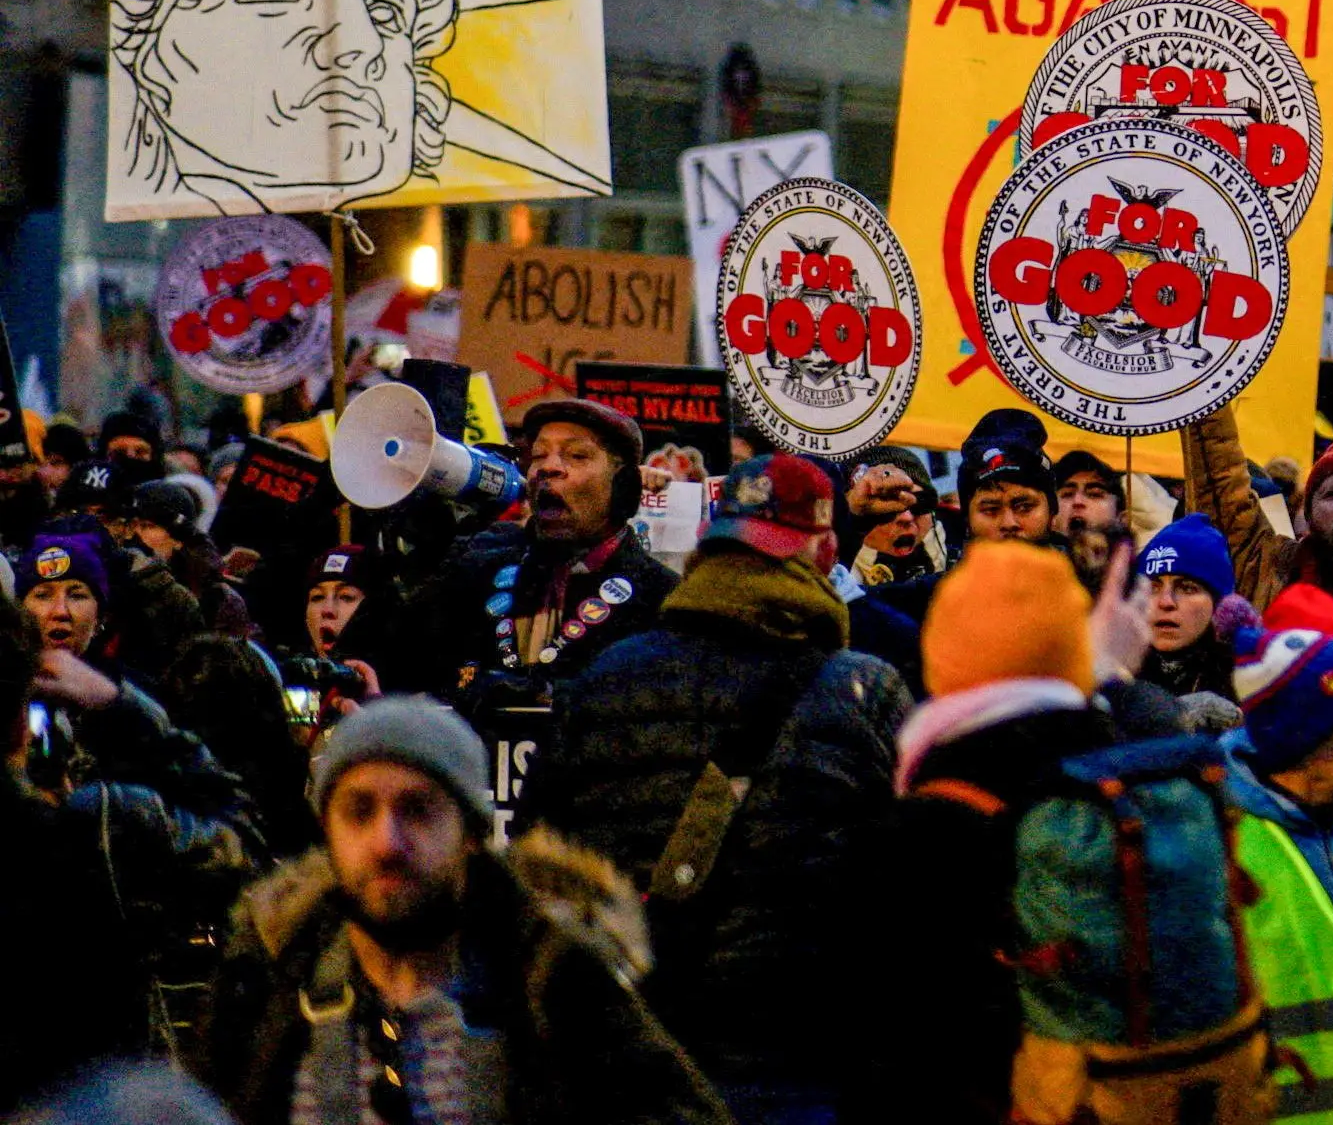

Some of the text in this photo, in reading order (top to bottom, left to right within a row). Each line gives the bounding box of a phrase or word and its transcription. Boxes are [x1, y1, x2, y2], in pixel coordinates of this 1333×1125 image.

[1048, 55, 1084, 103] THE
[1083, 16, 1133, 56] CITY
[1136, 8, 1167, 31] OF
[1175, 6, 1301, 119] MINNEAPOLIS
[1125, 39, 1220, 60] EN AVANT
[1120, 64, 1228, 107] FOR
[1000, 203, 1019, 233] OF
[1023, 158, 1067, 197] THE
[1079, 133, 1157, 158] STATE
[1174, 142, 1203, 161] OF
[1210, 161, 1252, 206] NEW
[1247, 206, 1275, 270] YORK
[1085, 194, 1199, 252] FOR
[203, 250, 269, 295] FOR
[726, 190, 910, 301] OF THE STATE OF NEW YORK
[780, 250, 856, 292] FOR
[170, 264, 332, 355] GOOD
[484, 258, 676, 334] ABOLISH
[988, 236, 1272, 341] GOOD
[724, 293, 913, 368] GOOD
[1076, 343, 1156, 366] EXCELSIOR
[1003, 332, 1128, 421] THE GREAT
[743, 380, 790, 436] GREAT
[797, 432, 832, 451] THE
[1145, 558, 1175, 575] UFT
